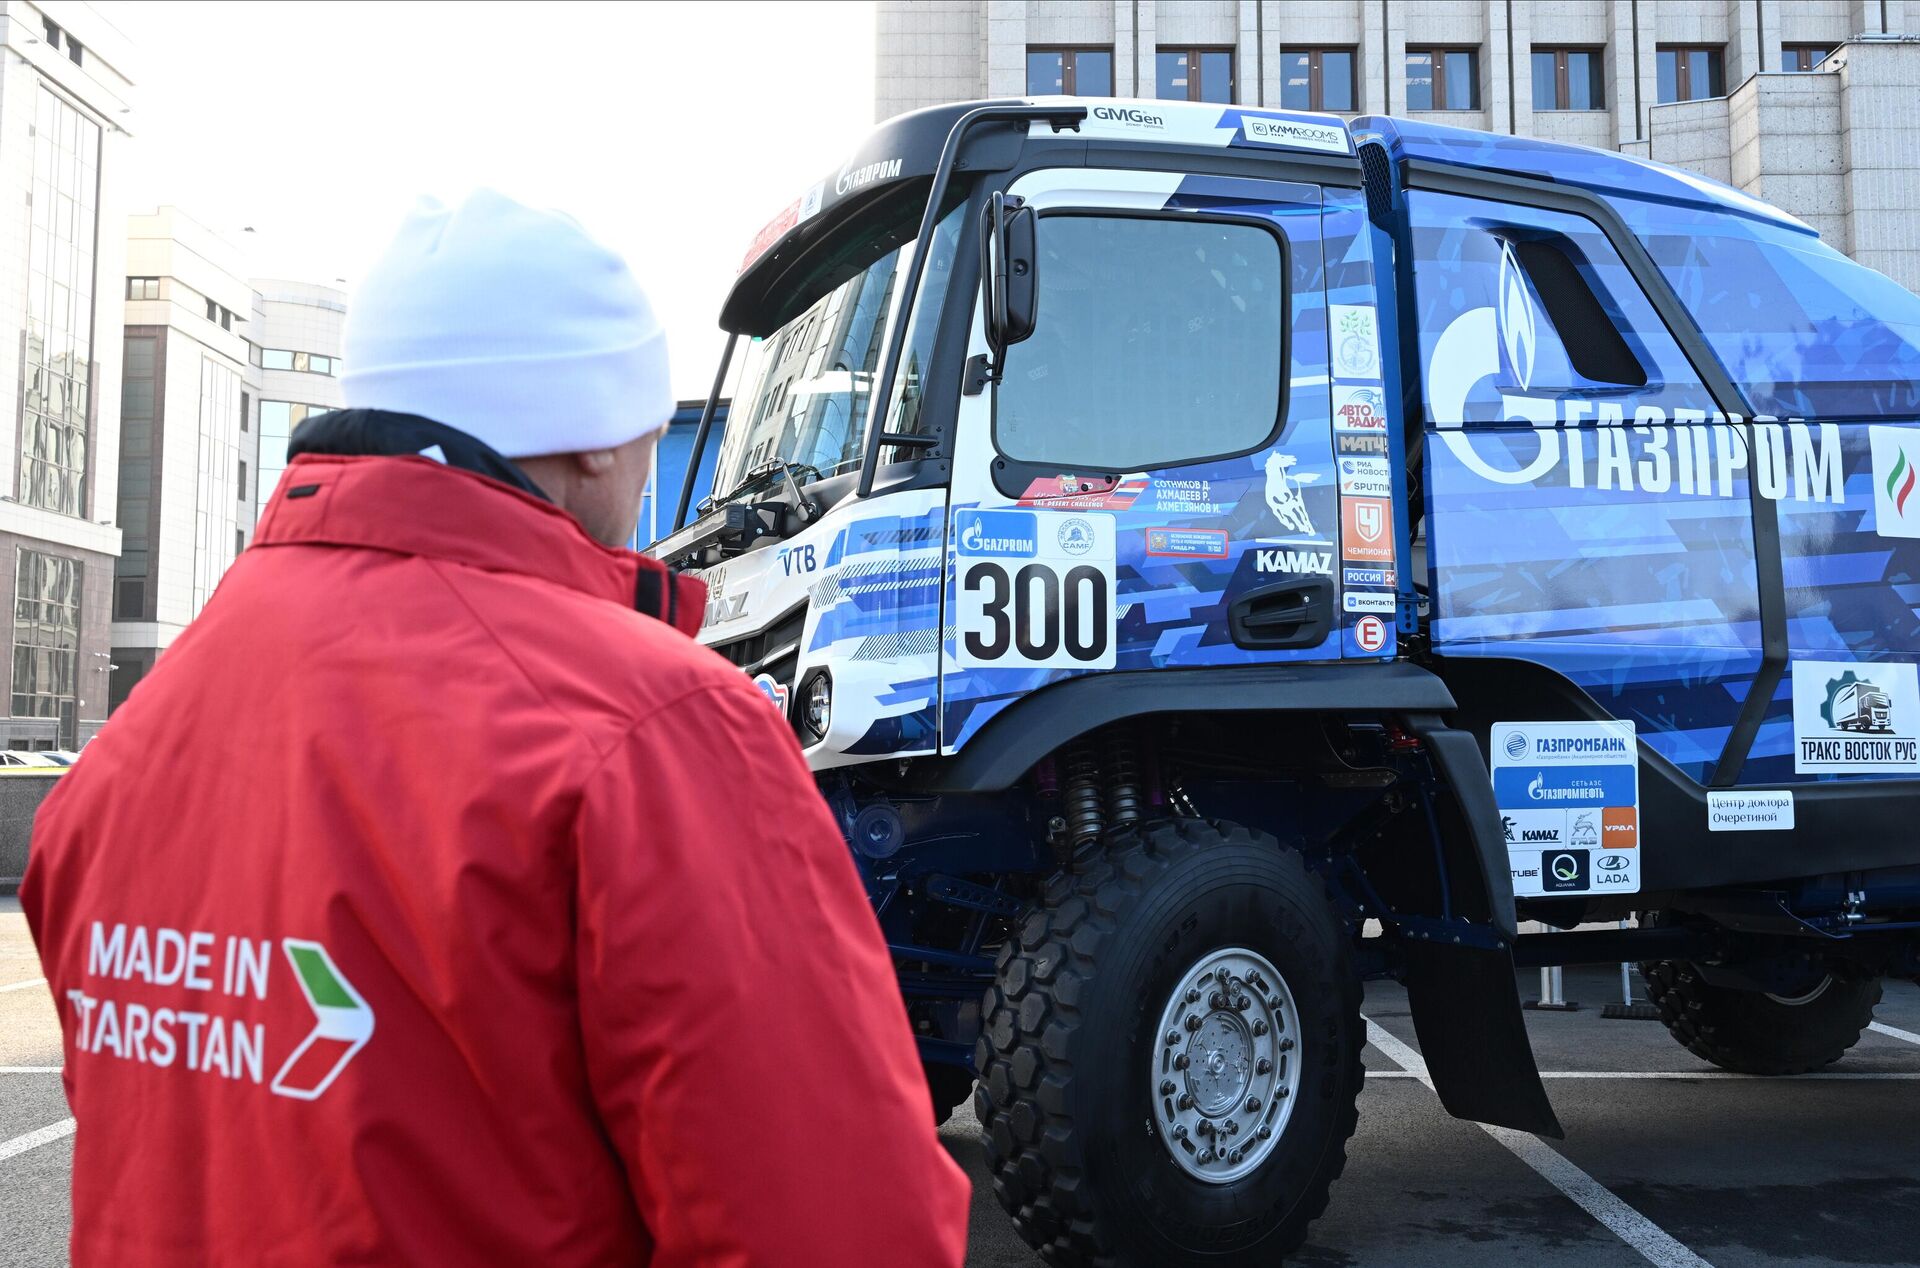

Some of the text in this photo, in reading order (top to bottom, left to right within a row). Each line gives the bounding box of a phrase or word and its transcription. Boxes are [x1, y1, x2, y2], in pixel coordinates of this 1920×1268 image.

[1093, 107, 1163, 125] GMGen
[848, 158, 902, 190] ГАЗПРОМ
[1337, 404, 1371, 416] АВТО
[1564, 400, 1845, 504] ГАЗПРОМ
[1357, 468, 1390, 476] НОВОСТ
[1154, 480, 1211, 491] СОТНИКОВ Д.
[1156, 490, 1210, 501] АХМАДЕЕВ Р.
[1156, 502, 1211, 513] АХМЕТЗЯНОВ
[983, 538, 1033, 552] GAZPROM
[1347, 547, 1391, 556] ЧЕМПИОНАТ
[783, 543, 817, 576] VTB
[1256, 550, 1333, 575] KAMAZ
[1347, 572, 1381, 582] РОССИЯ
[964, 562, 1107, 661] 300
[1363, 623, 1378, 645] E
[1536, 737, 1626, 753] ГАЗПРОМБАНК
[1801, 741, 1917, 761] ТРАКС ВОСТОК РУС
[1543, 788, 1605, 800] ГАЗПРОМНЕФТЬ
[1711, 798, 1789, 810] Центр доктора
[1713, 812, 1777, 824] Очеретиной
[1522, 829, 1559, 841] KAMAZ
[1511, 869, 1538, 877] TUBE
[1596, 874, 1630, 884] LADA
[88, 921, 272, 1000] MADE IN
